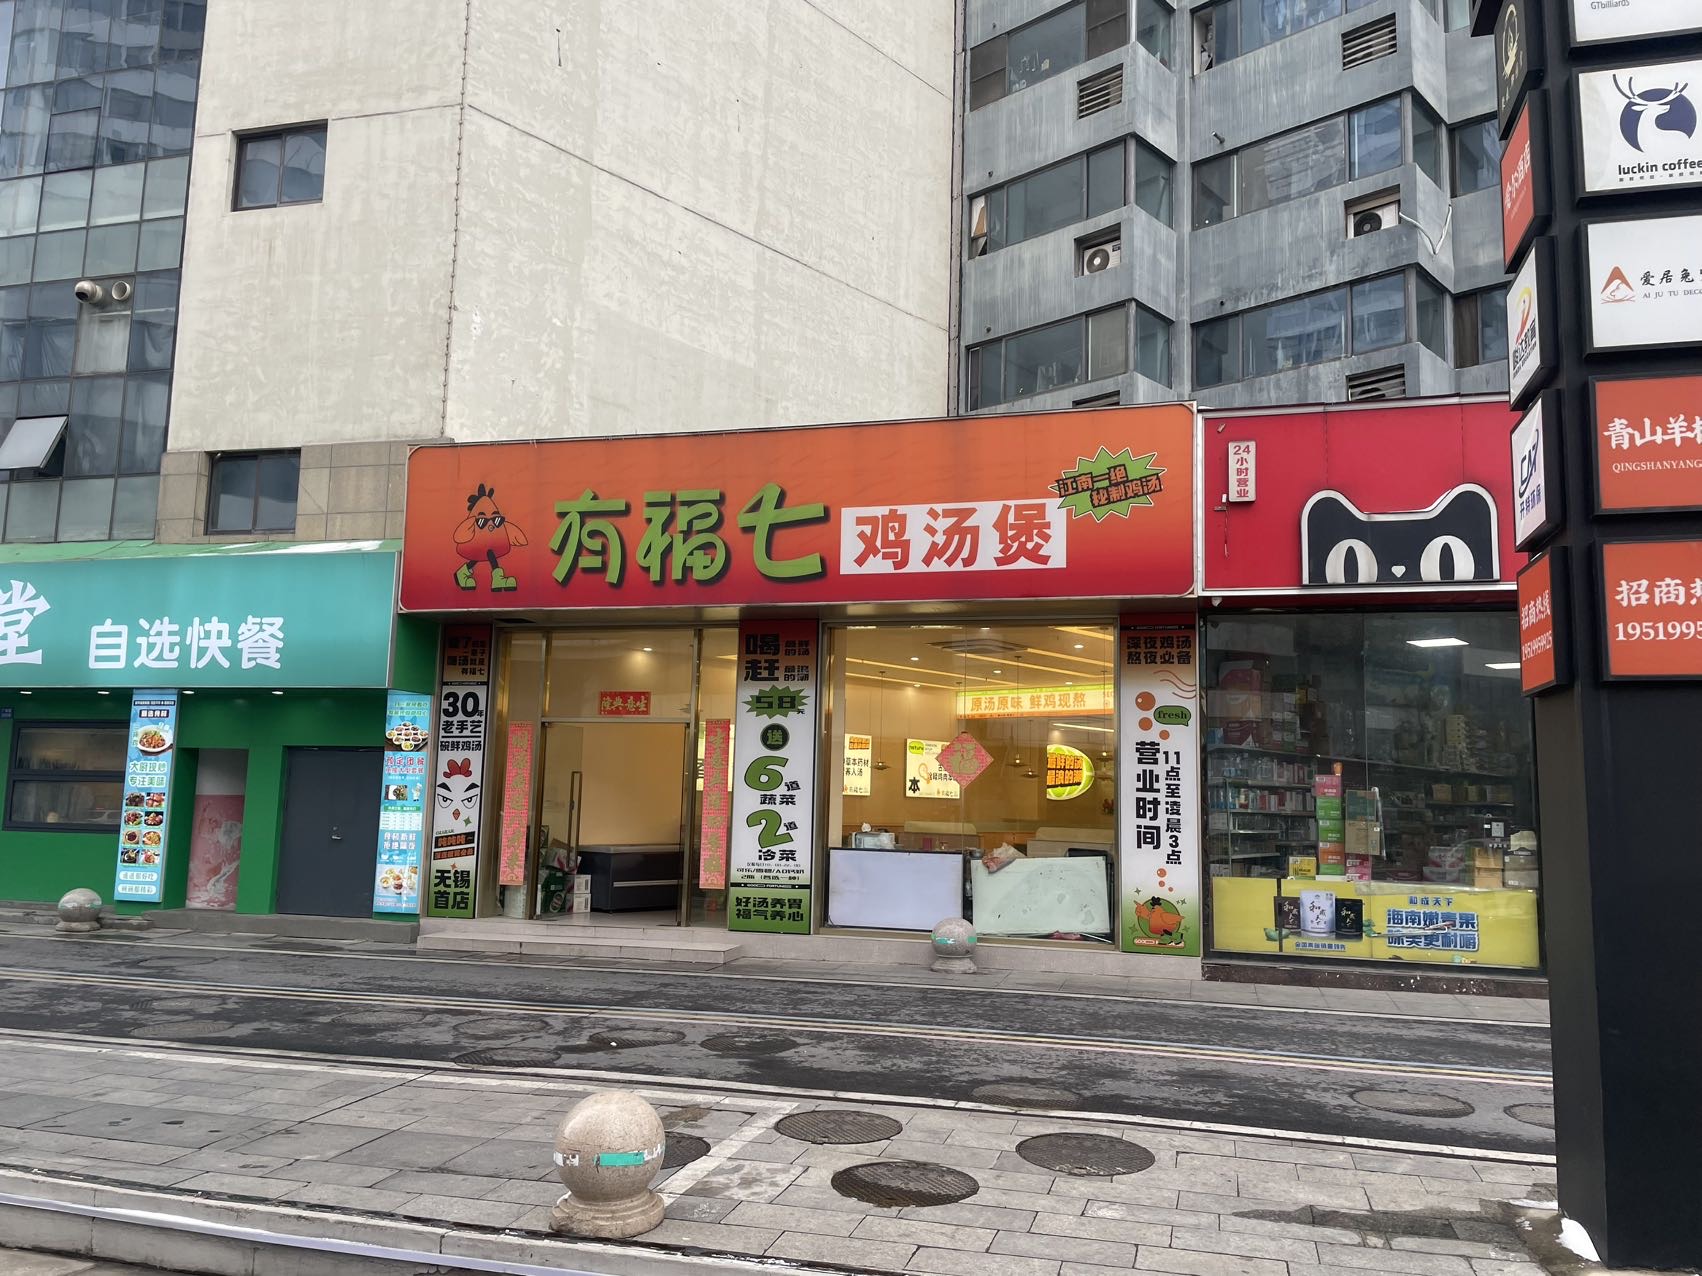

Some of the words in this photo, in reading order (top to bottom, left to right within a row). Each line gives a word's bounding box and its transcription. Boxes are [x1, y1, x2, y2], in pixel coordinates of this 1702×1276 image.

[1618, 162, 1658, 175] luckin
[1662, 158, 1702, 171] coffee
[1640, 268, 1702, 286] 爱居兔
[1669, 289, 1678, 297] TU
[1057, 464, 1128, 498] 江南一绝
[1091, 474, 1162, 508] 秘制鸡汤
[548, 481, 828, 586] 有福七
[853, 501, 1052, 571] 鸡汤煲
[0, 579, 51, 665] 堂
[88, 615, 284, 670] 自选快餐
[744, 633, 780, 657] 喝
[1126, 635, 1192, 650] 深夜鸡汤
[1126, 650, 1192, 665] 熬夜必备
[744, 658, 780, 682] 赶
[442, 691, 484, 718] 30年
[970, 695, 1024, 712] 原汤原味
[1029, 692, 1087, 710] 鲜鸡现熬
[1157, 710, 1188, 720] fresh
[441, 720, 483, 734] 老手艺
[766, 729, 783, 745] 送
[844, 757, 869, 767] 草本药材
[743, 755, 790, 792] 6
[759, 793, 797, 806] 蔬菜
[1135, 741, 1161, 850] 营业时间
[1162, 750, 1182, 865] 11点至凌晨3点
[745, 808, 794, 849] 2
[757, 849, 798, 862] 冷菜
[434, 869, 471, 889] 无锡
[434, 890, 470, 910] 首店
[735, 896, 803, 910] 好汤养胃
[1408, 895, 1454, 907] 和成天下
[735, 909, 804, 922] 福气养心
